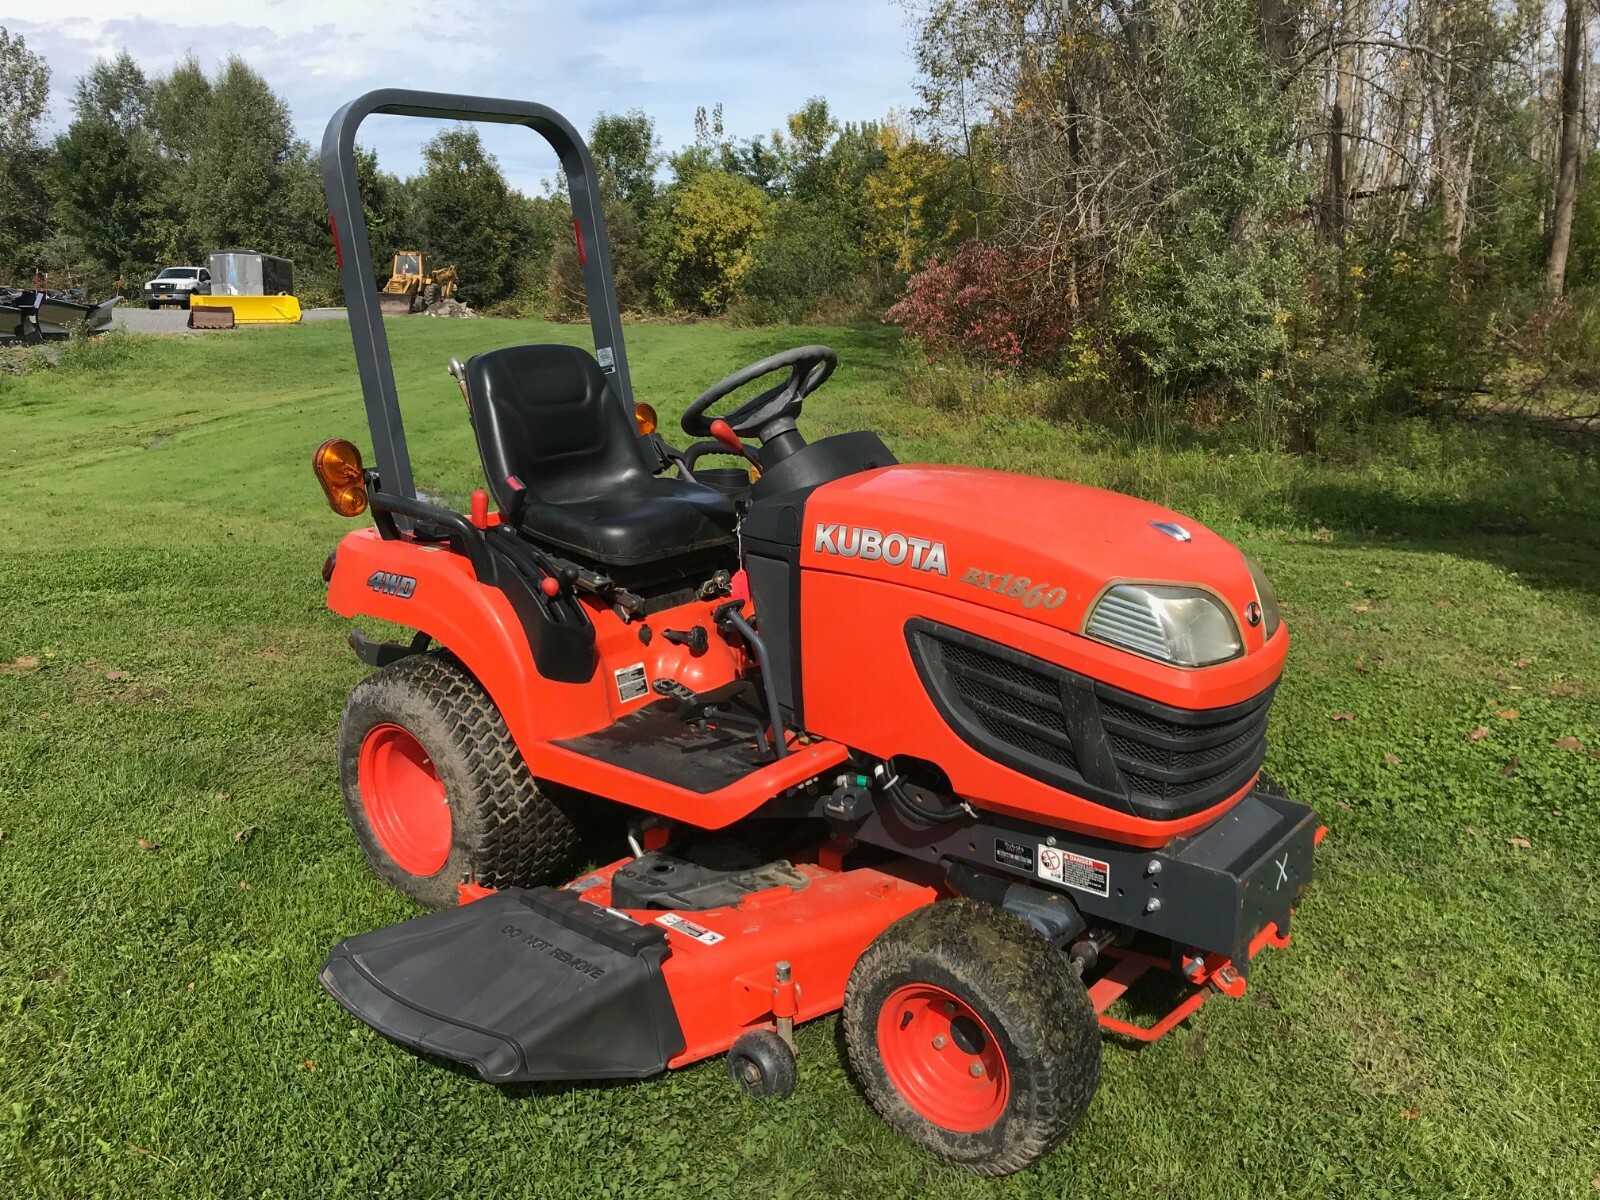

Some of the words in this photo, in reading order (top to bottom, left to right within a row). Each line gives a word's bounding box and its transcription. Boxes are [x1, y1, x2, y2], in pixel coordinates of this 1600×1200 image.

[814, 523, 948, 576] KUBOTA
[367, 570, 417, 599] 4WD
[1069, 855, 1094, 867] DANGER
[501, 925, 522, 938] DO
[523, 934, 553, 953] NOT
[549, 948, 605, 980] REMOVE
